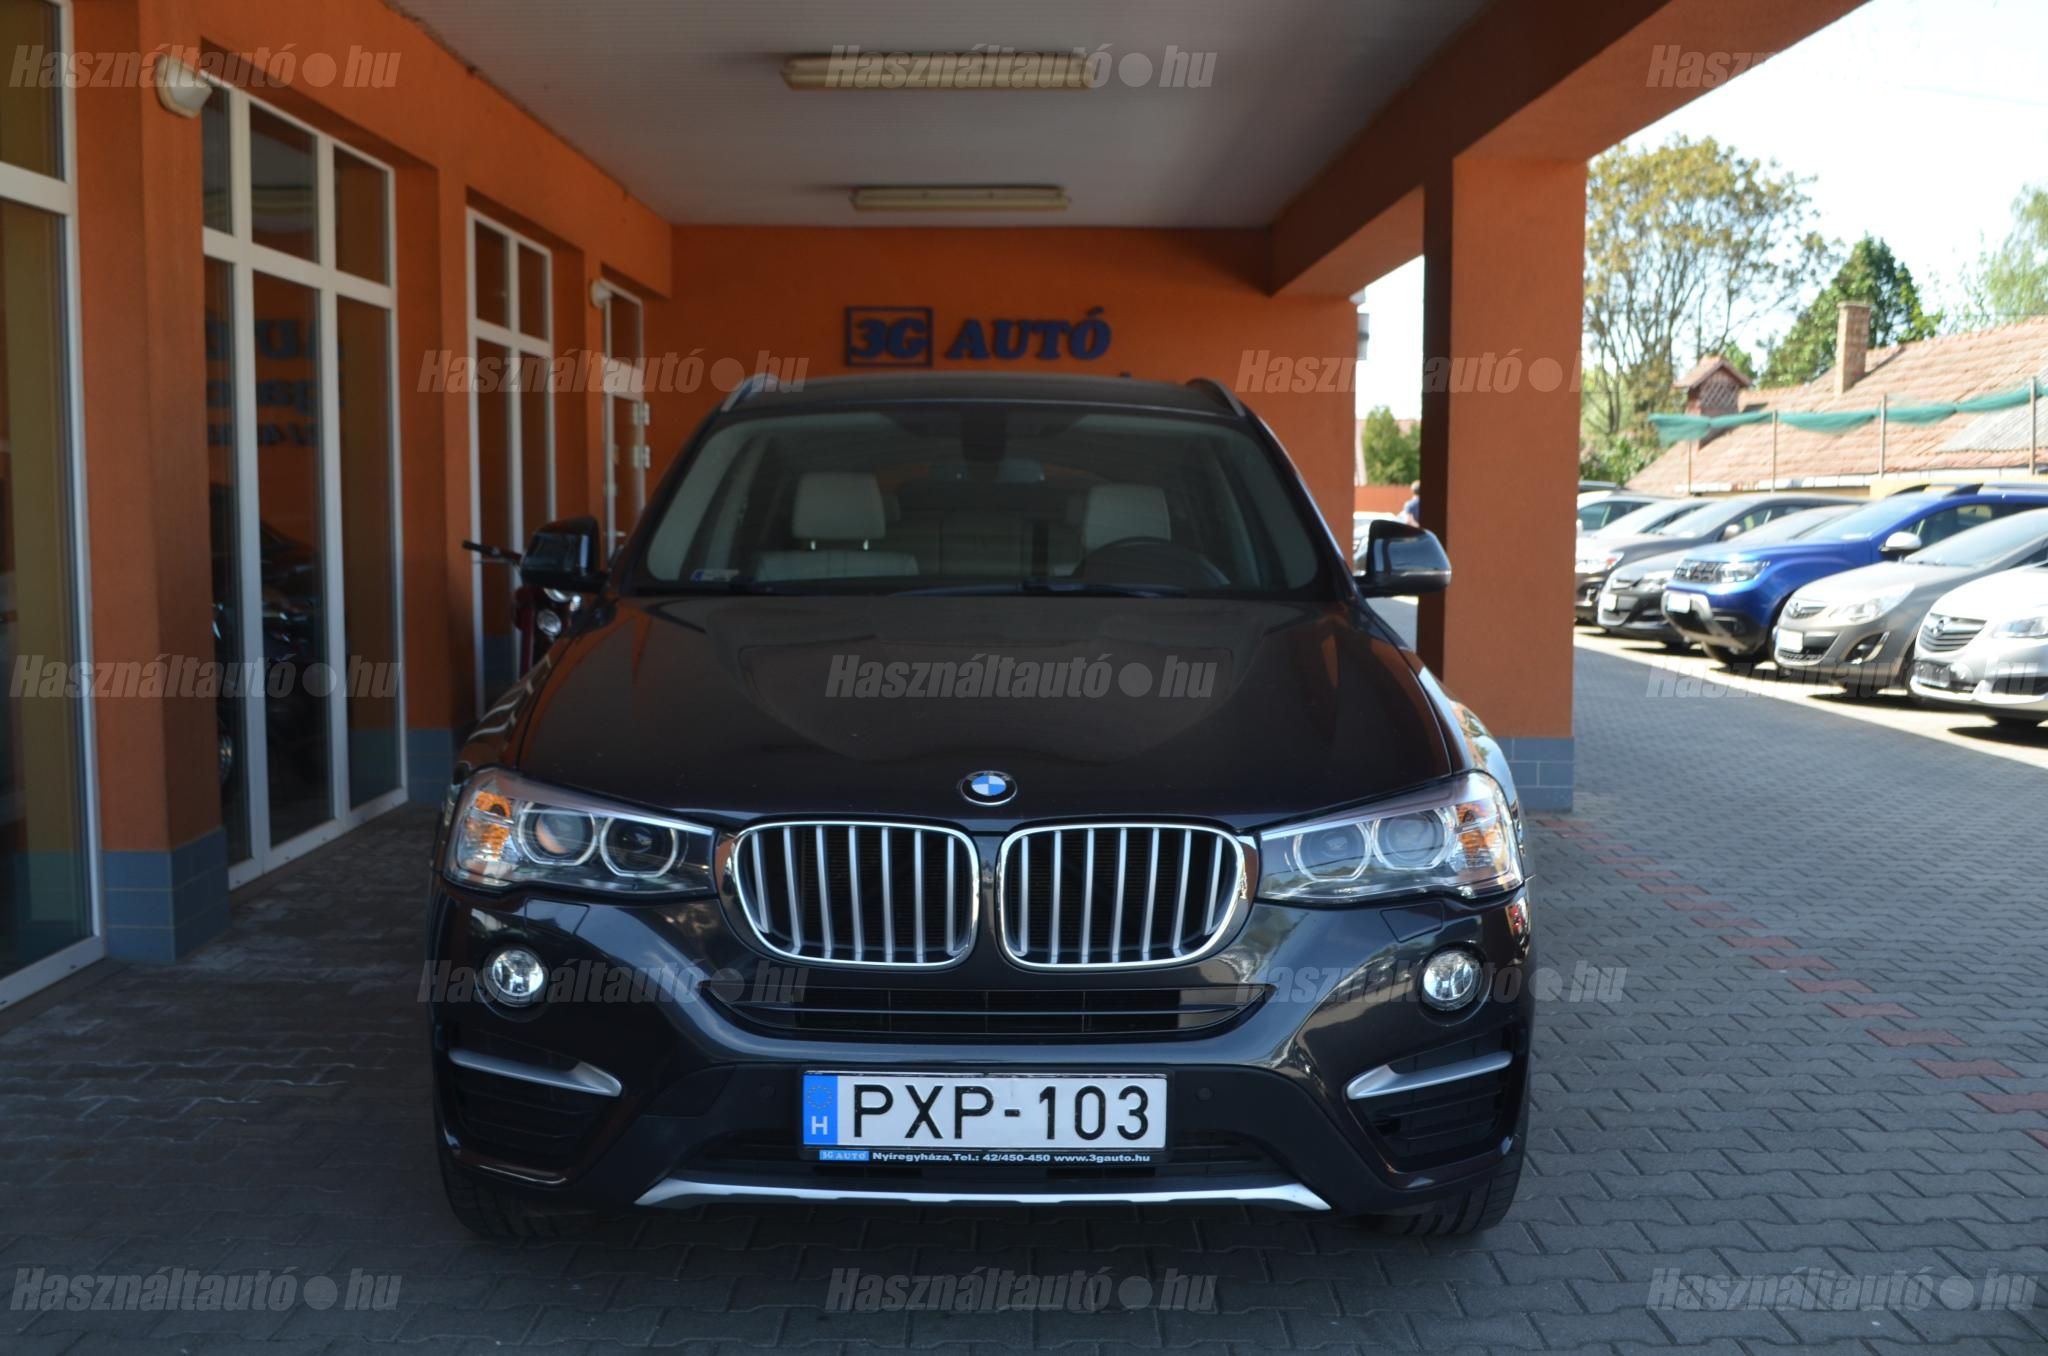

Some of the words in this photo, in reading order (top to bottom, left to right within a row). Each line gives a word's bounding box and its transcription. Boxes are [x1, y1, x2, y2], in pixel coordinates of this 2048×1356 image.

[849, 317, 929, 358] 3G
[944, 306, 1111, 360] AUTÓ
[811, 1115, 828, 1135] H
[853, 1084, 1149, 1140] PXP-103
[982, 1153, 1050, 1162] 42/450-450
[1054, 1153, 1150, 1163] www.3gauto.hu
